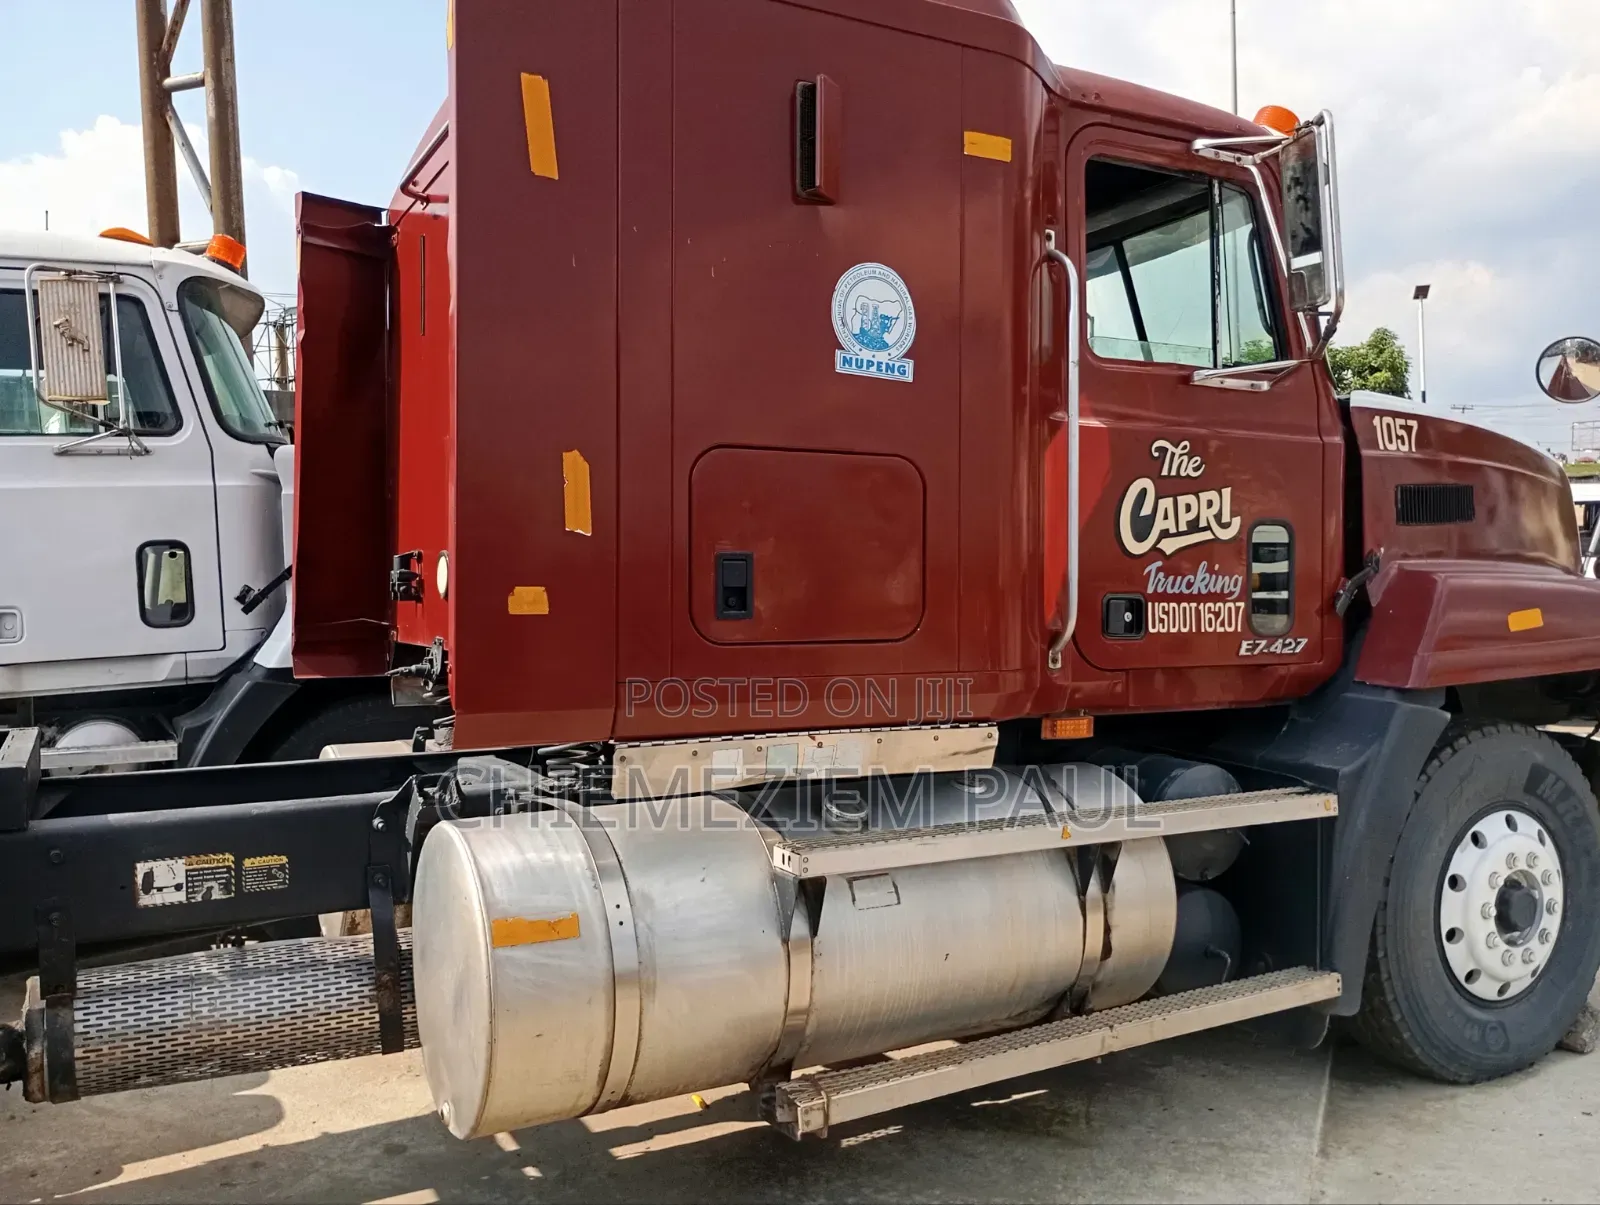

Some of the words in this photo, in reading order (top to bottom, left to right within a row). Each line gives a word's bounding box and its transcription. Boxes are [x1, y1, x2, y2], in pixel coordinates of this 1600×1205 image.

[844, 269, 877, 289] PETROLEUM
[877, 270, 891, 280] AND
[890, 277, 909, 305] NATURAL
[895, 322, 913, 352] WORKERS
[841, 355, 907, 376] NUPENG
[1372, 415, 1418, 453] 1057
[1151, 439, 1205, 477] The
[1119, 477, 1242, 556] CAPRI
[1143, 560, 1243, 600] Trucking
[1147, 602, 1197, 634] USDOT
[1198, 601, 1245, 633] 16207
[1238, 638, 1308, 657] E7-427
[195, 857, 230, 866] CAUTION
[257, 857, 284, 865] CAUTION
